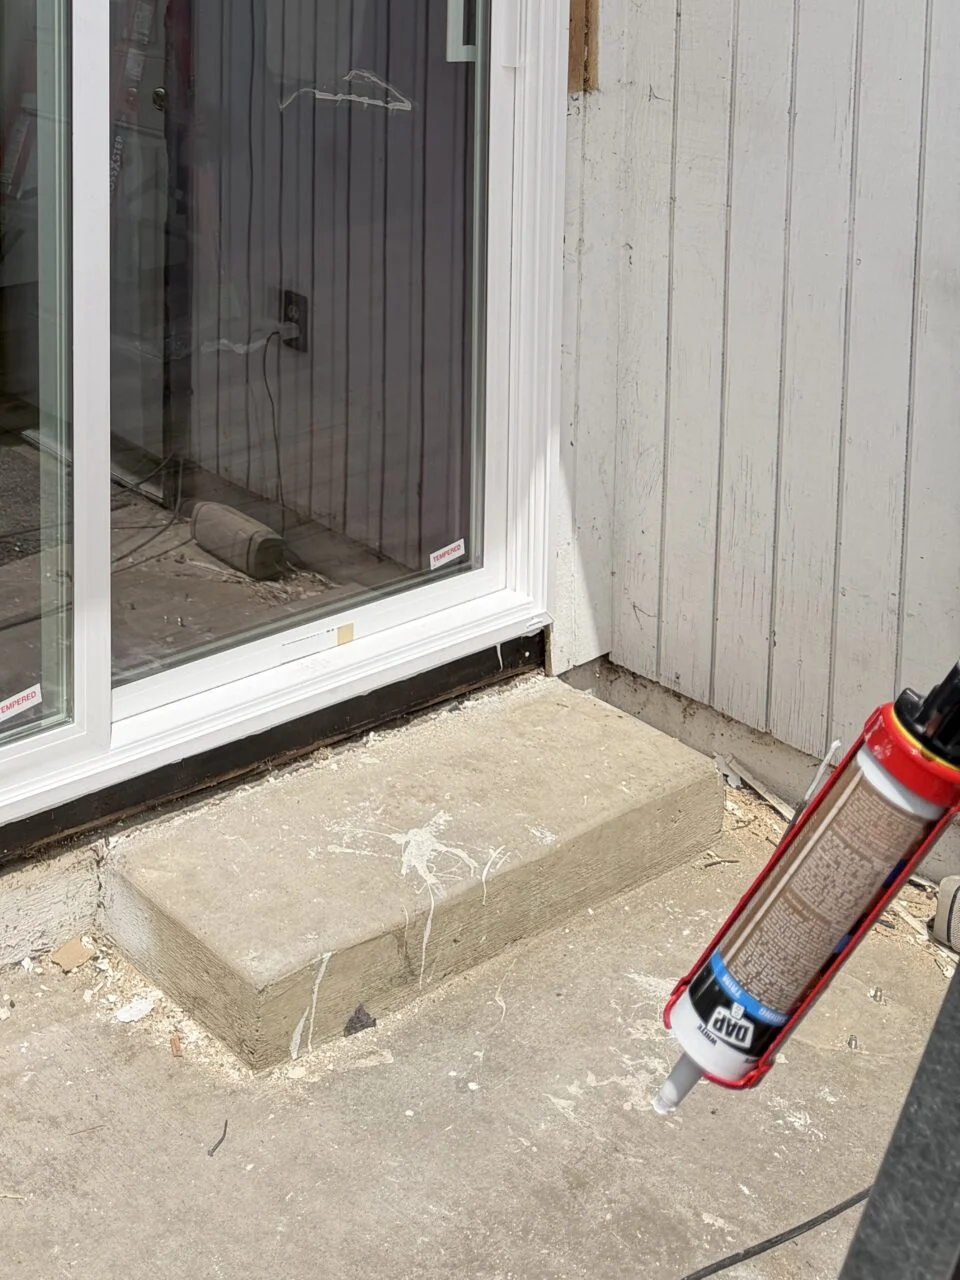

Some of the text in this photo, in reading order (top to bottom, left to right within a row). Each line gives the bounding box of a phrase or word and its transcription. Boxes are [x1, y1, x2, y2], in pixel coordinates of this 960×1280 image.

[433, 544, 461, 562] TEMPERED
[721, 974, 743, 998] TRIM
[696, 1023, 718, 1047] WHITE
[712, 1015, 750, 1042] DAP
